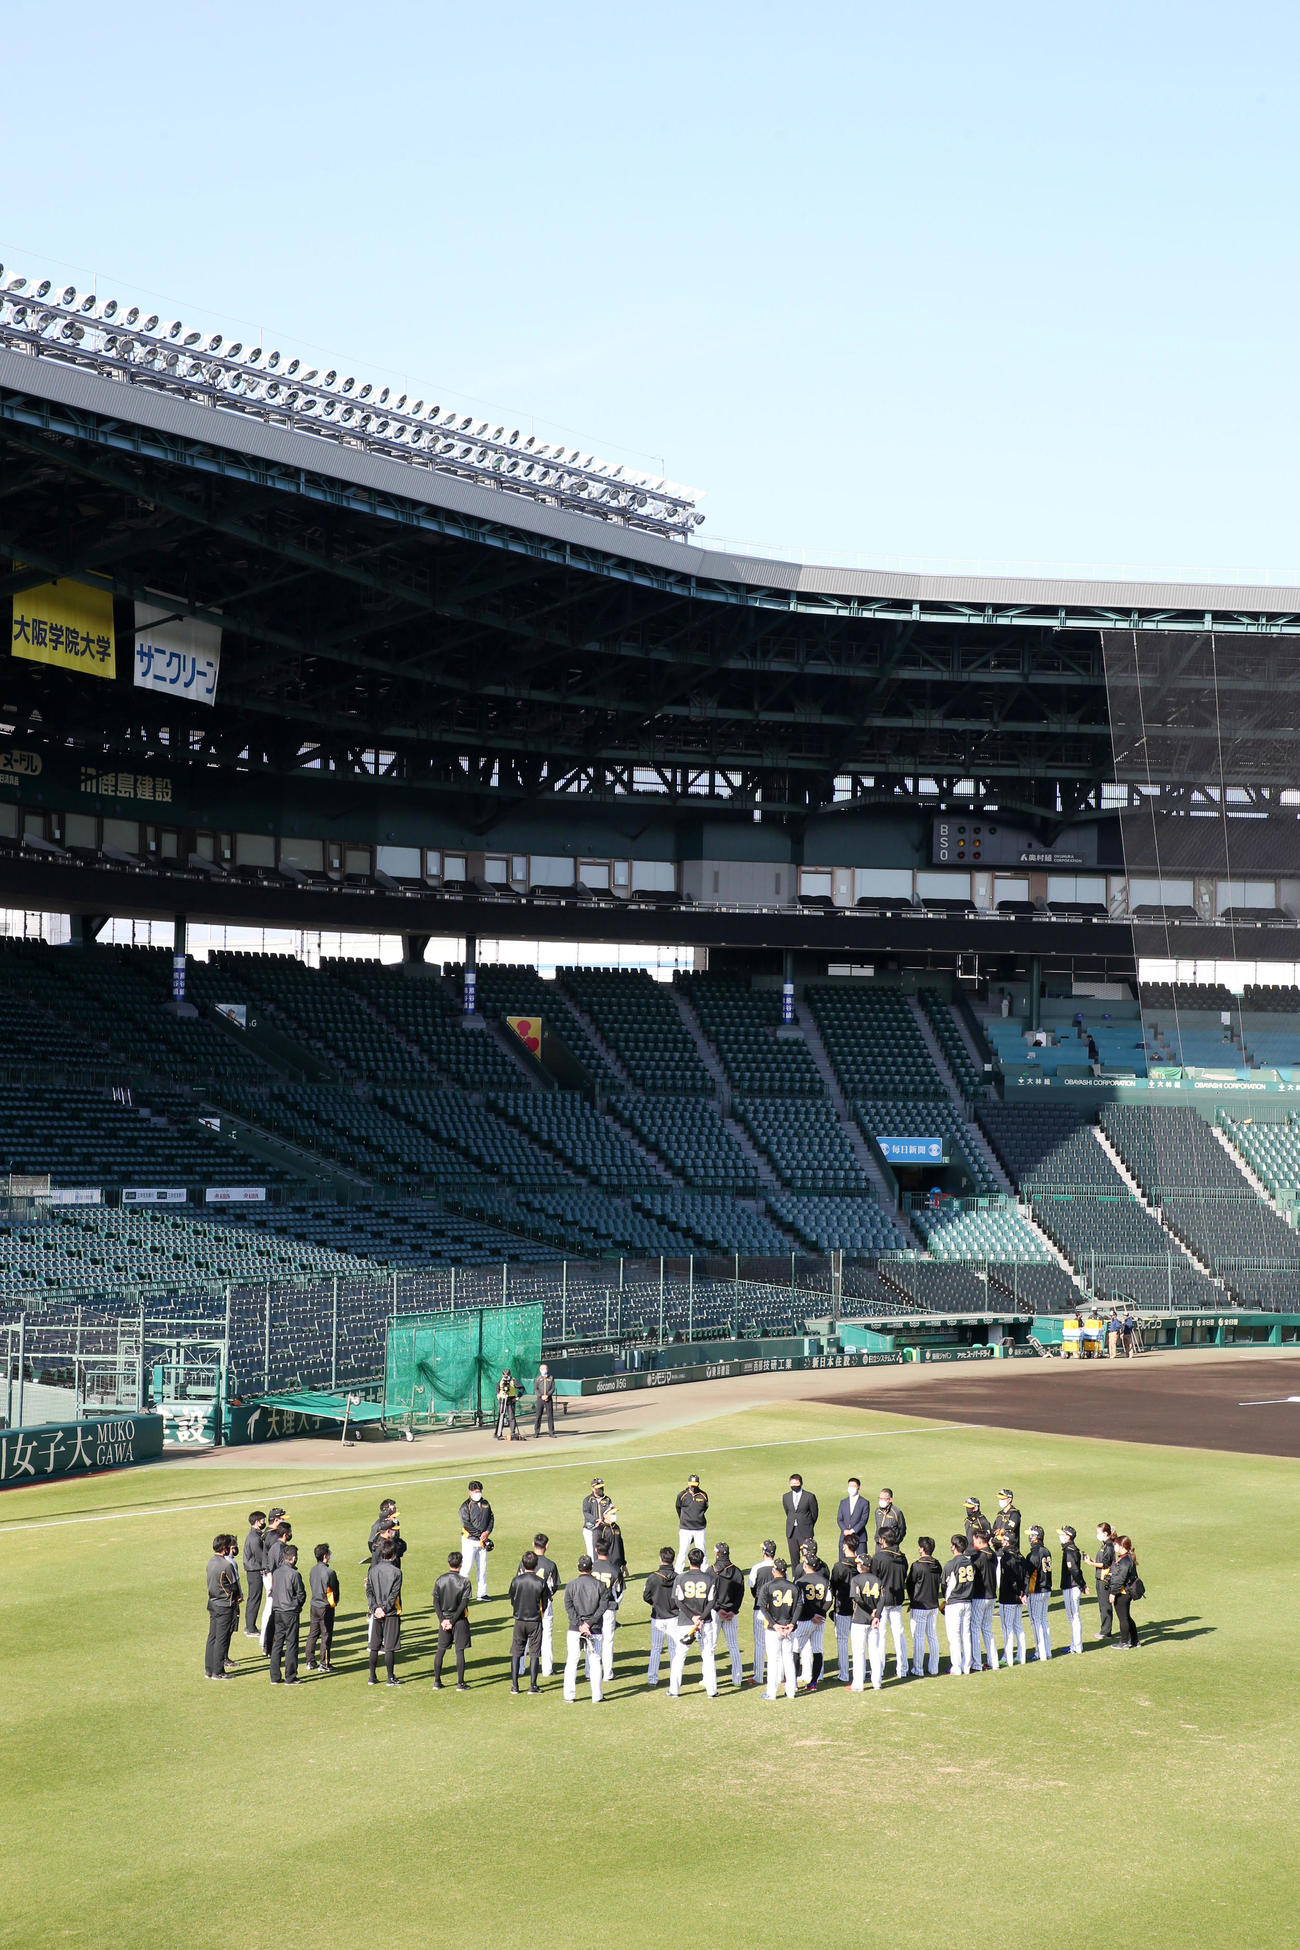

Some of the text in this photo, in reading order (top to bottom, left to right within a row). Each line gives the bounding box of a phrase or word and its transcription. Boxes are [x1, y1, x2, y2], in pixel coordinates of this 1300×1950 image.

[14, 614, 111, 663] 大阪学院大学
[136, 642, 216, 694] サニクリーン
[940, 824, 949, 836] B
[940, 837, 949, 848] S
[1093, 1079, 1136, 1087] CORPORATION
[1157, 1081, 1181, 1089] 大林組
[892, 1144, 926, 1154] 毎日新聞
[812, 1356, 851, 1368] 新日本住設
[868, 1354, 896, 1363] 日立システムズ
[651, 1371, 672, 1385] シモジマ
[597, 1381, 615, 1392] docomo
[97, 1419, 135, 1444] MUKO
[97, 1441, 134, 1466] GAWA
[684, 1581, 707, 1599] 92
[805, 1584, 825, 1601] 33
[862, 1581, 880, 1599] 44
[772, 1589, 793, 1607] 34
